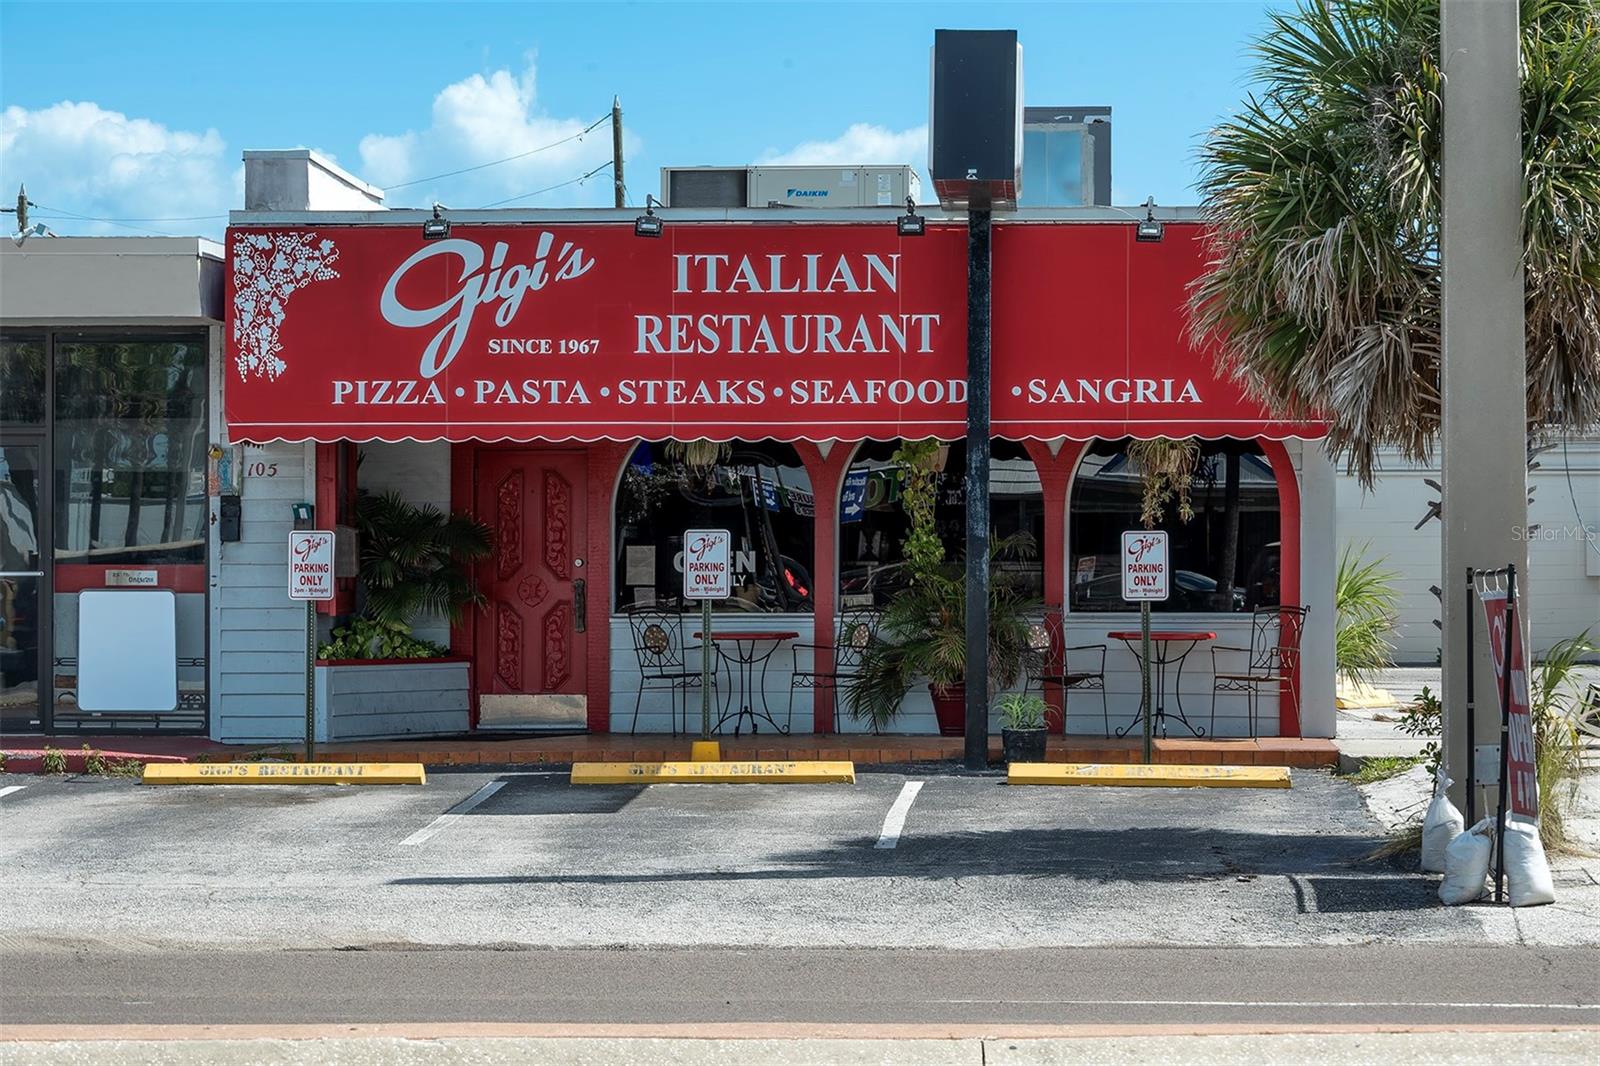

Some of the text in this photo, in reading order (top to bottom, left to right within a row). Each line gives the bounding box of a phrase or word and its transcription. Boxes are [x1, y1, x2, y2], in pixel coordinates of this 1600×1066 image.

[795, 190, 829, 198] DAIKIN
[672, 253, 902, 293] ITALIAN
[380, 232, 595, 379] Gigi's
[634, 313, 940, 354] RESTAURANT
[488, 339, 600, 355] SINCE 1967
[332, 379, 1203, 406] PIZZA PASTA STEAKS SEAFOOD SANGRIA
[247, 462, 278, 477] 105
[294, 564, 329, 573] PARKING
[689, 563, 725, 572] PARKING
[1128, 564, 1163, 573] PARKING
[299, 576, 323, 586] ONLY
[695, 575, 719, 585] ONLY
[1134, 576, 1157, 586] ONLY
